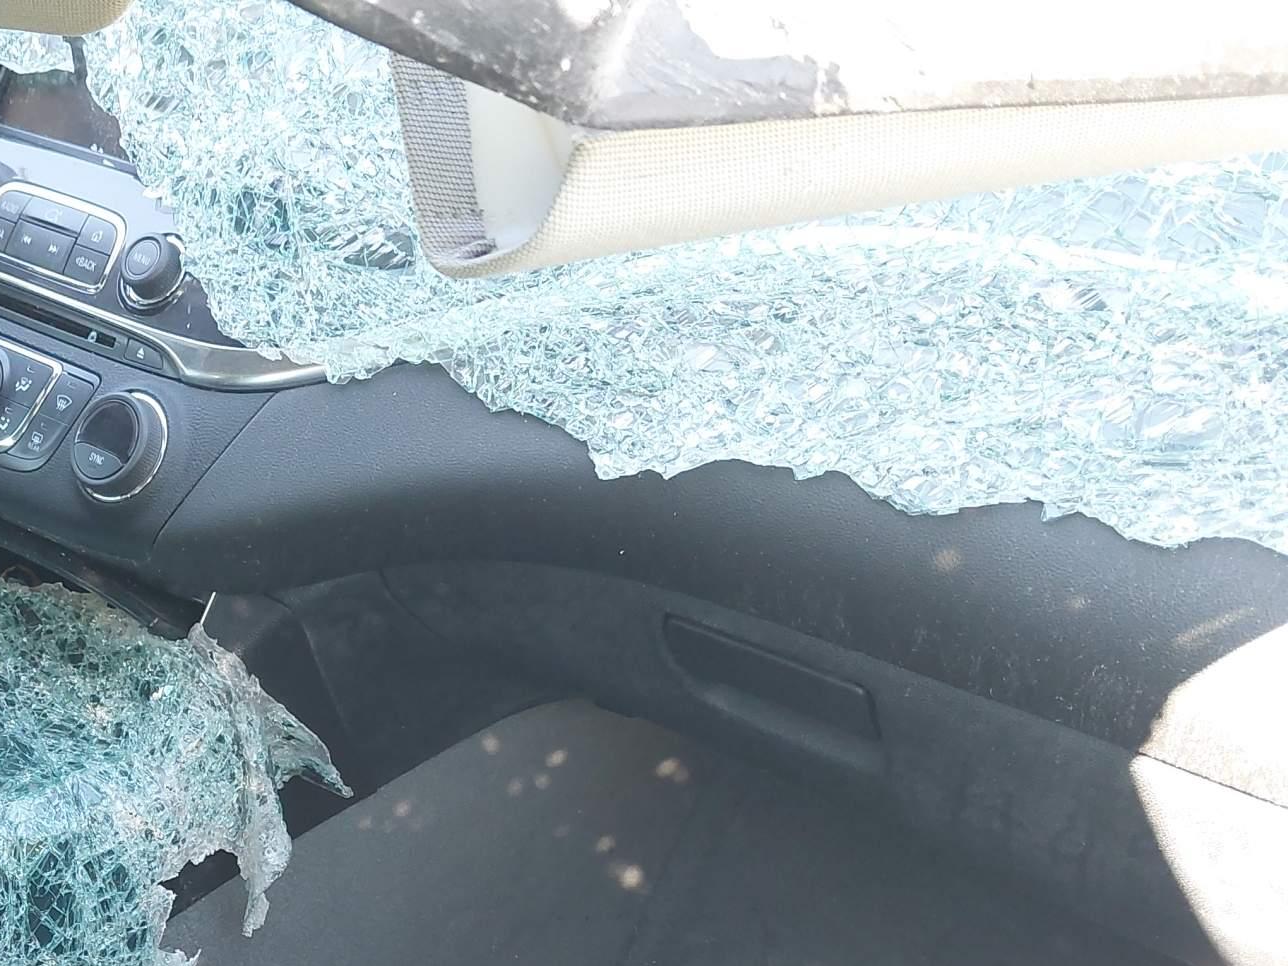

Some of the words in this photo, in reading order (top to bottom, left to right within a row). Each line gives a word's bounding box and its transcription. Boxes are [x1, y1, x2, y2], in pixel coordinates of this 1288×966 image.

[79, 256, 97, 272] BACK
[132, 251, 152, 267] MENU
[88, 451, 105, 465] SYNC
